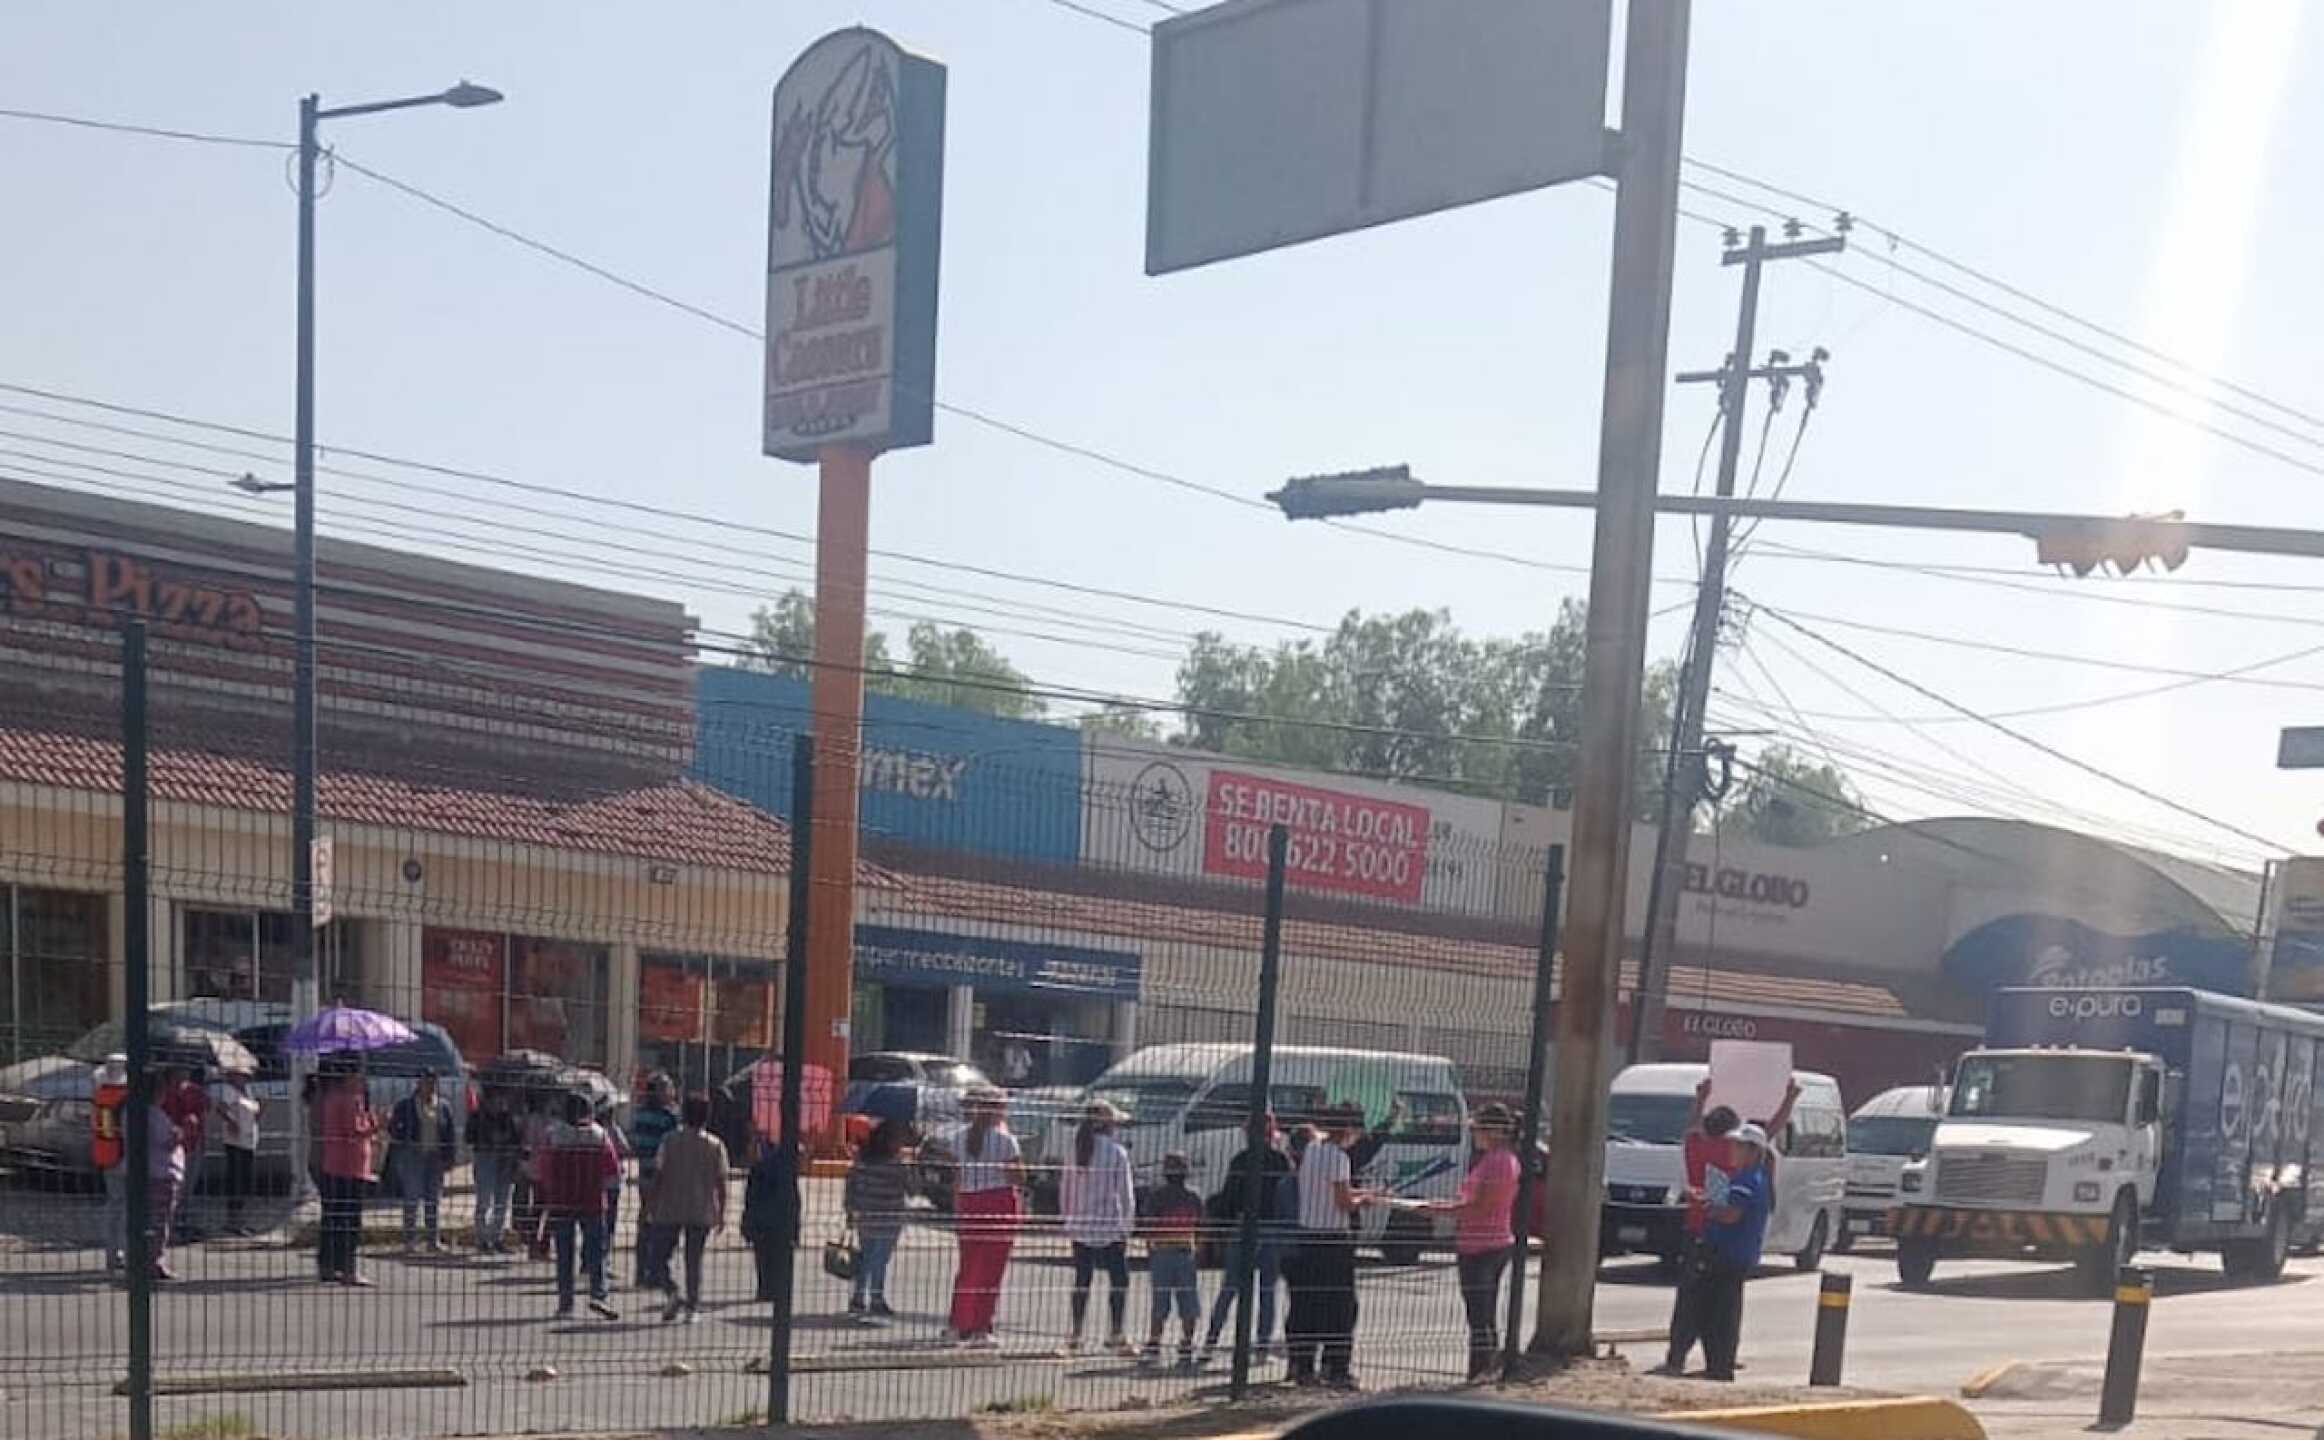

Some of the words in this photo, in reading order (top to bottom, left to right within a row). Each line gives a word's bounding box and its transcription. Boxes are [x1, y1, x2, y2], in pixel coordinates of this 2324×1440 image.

[863, 748, 966, 799] mex
[1218, 783, 1249, 819] SE
[1253, 790, 1337, 833] RENTA
[1344, 805, 1418, 849] LOCAL
[1286, 831, 1337, 876] 622
[1345, 842, 1410, 886] 5000
